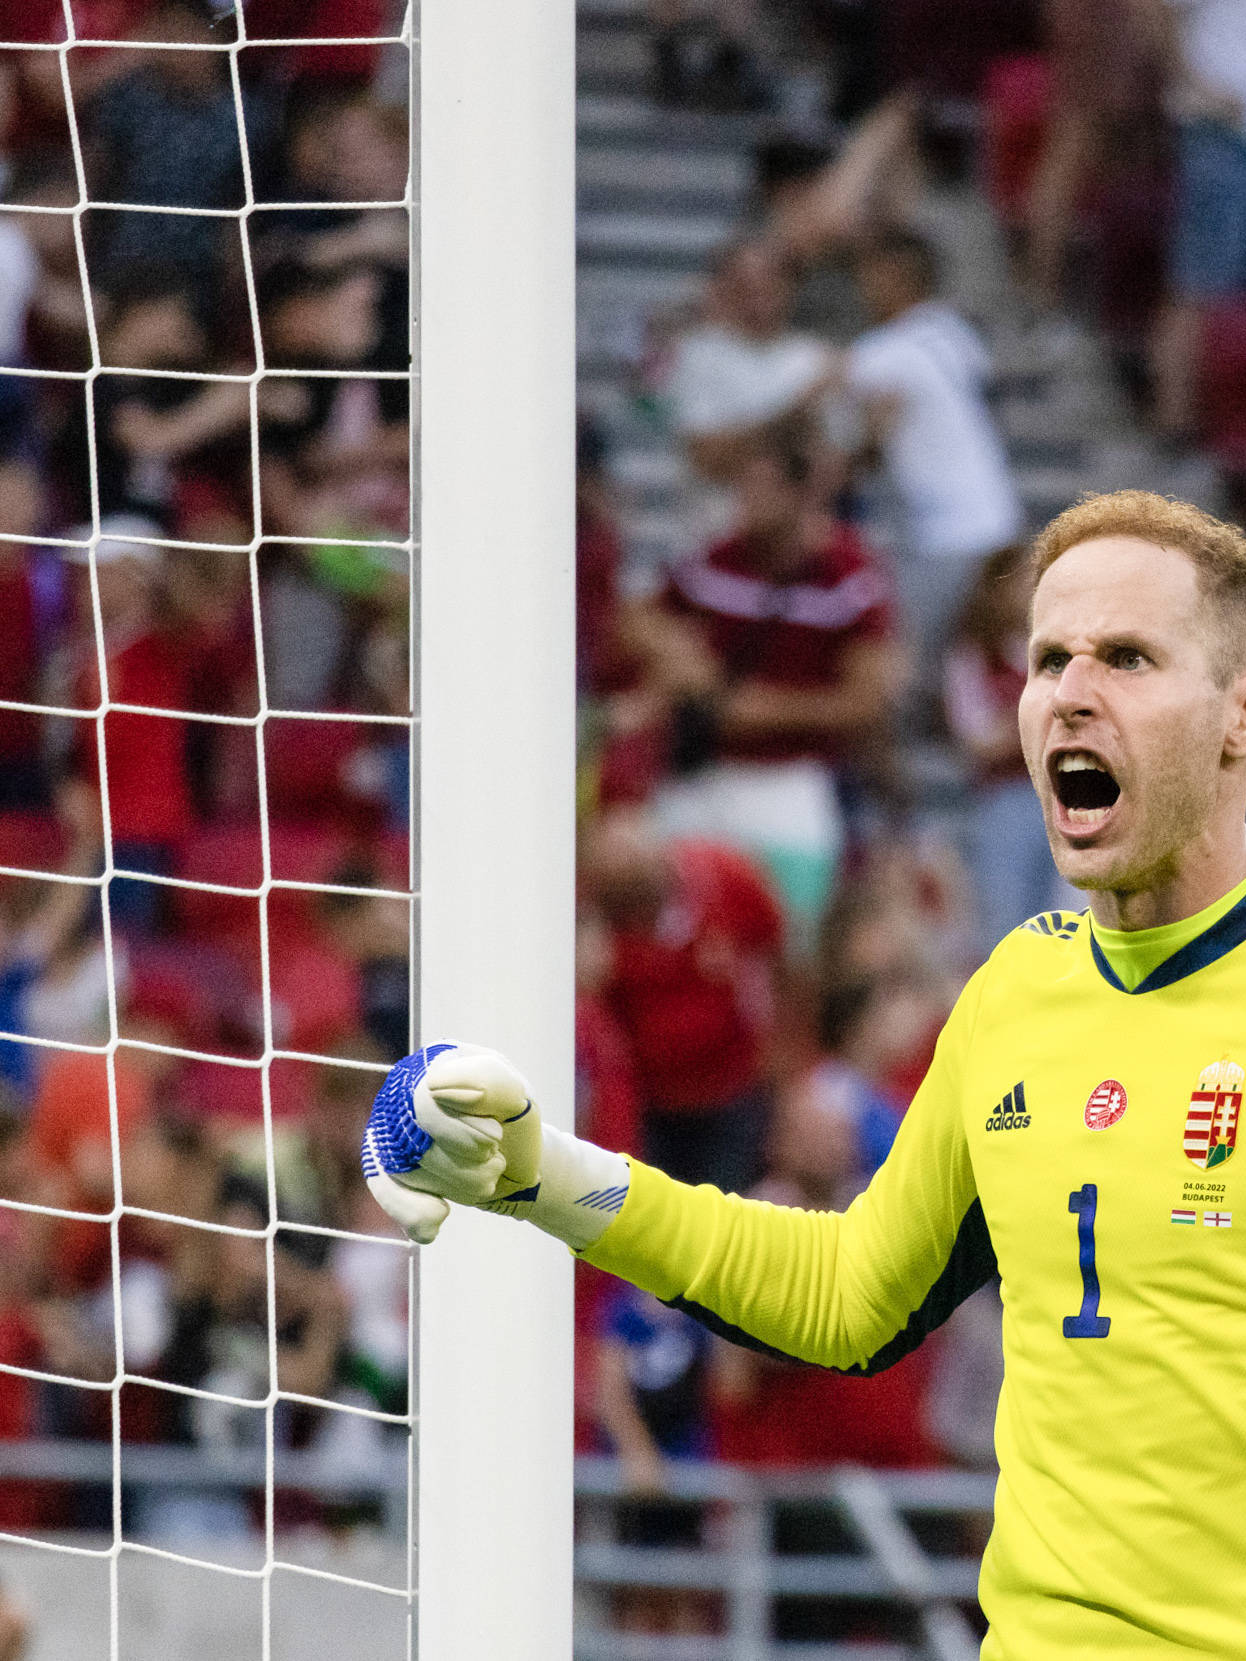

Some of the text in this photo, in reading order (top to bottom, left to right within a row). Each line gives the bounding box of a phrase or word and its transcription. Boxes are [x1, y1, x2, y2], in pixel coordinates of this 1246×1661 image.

[986, 1111, 1032, 1131] adidas
[1183, 1182, 1226, 1192] 04.06.2022
[1182, 1193, 1225, 1203] BUDAPEST
[1062, 1183, 1111, 1338] 1
